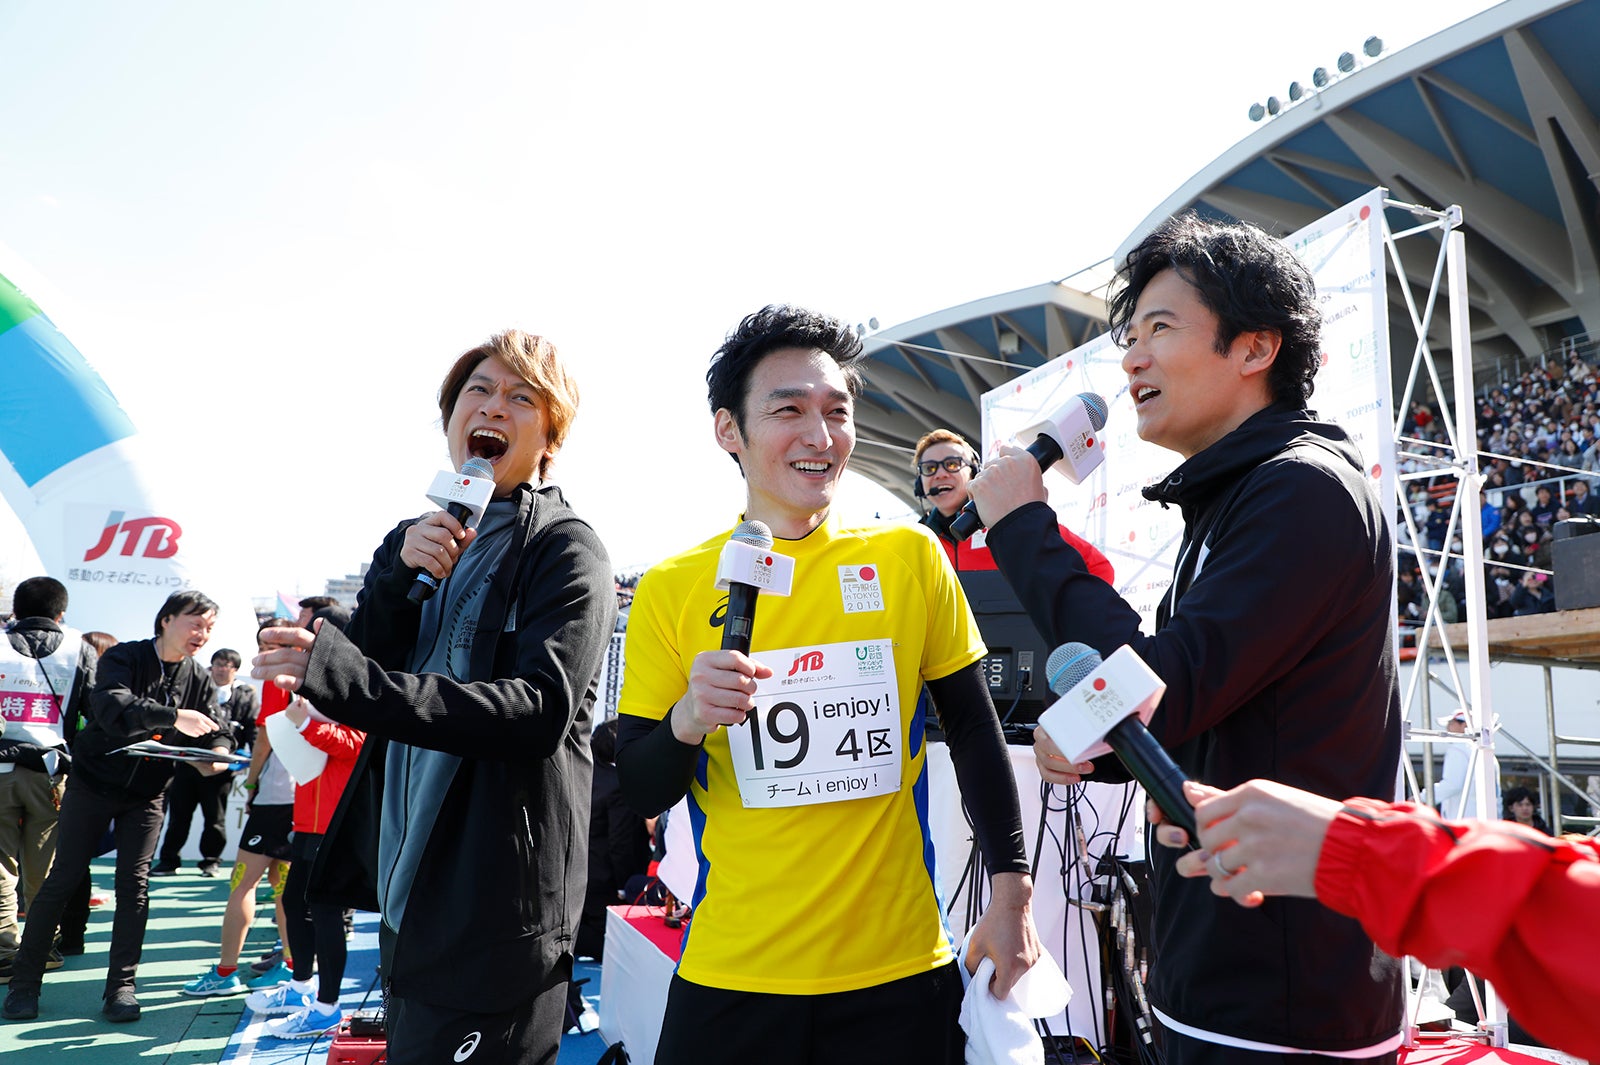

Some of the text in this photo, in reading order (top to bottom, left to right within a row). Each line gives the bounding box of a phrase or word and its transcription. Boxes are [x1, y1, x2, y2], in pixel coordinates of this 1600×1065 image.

[1340, 268, 1377, 293] TOPPAN
[1346, 399, 1383, 420] TOPPAN
[1088, 491, 1107, 513] JTB
[83, 510, 183, 562] JTB
[847, 600, 881, 611] 2019
[853, 591, 880, 600] TOKYO
[1137, 603, 1153, 613] JAL
[788, 651, 824, 677] JTB
[739, 701, 810, 771] 19
